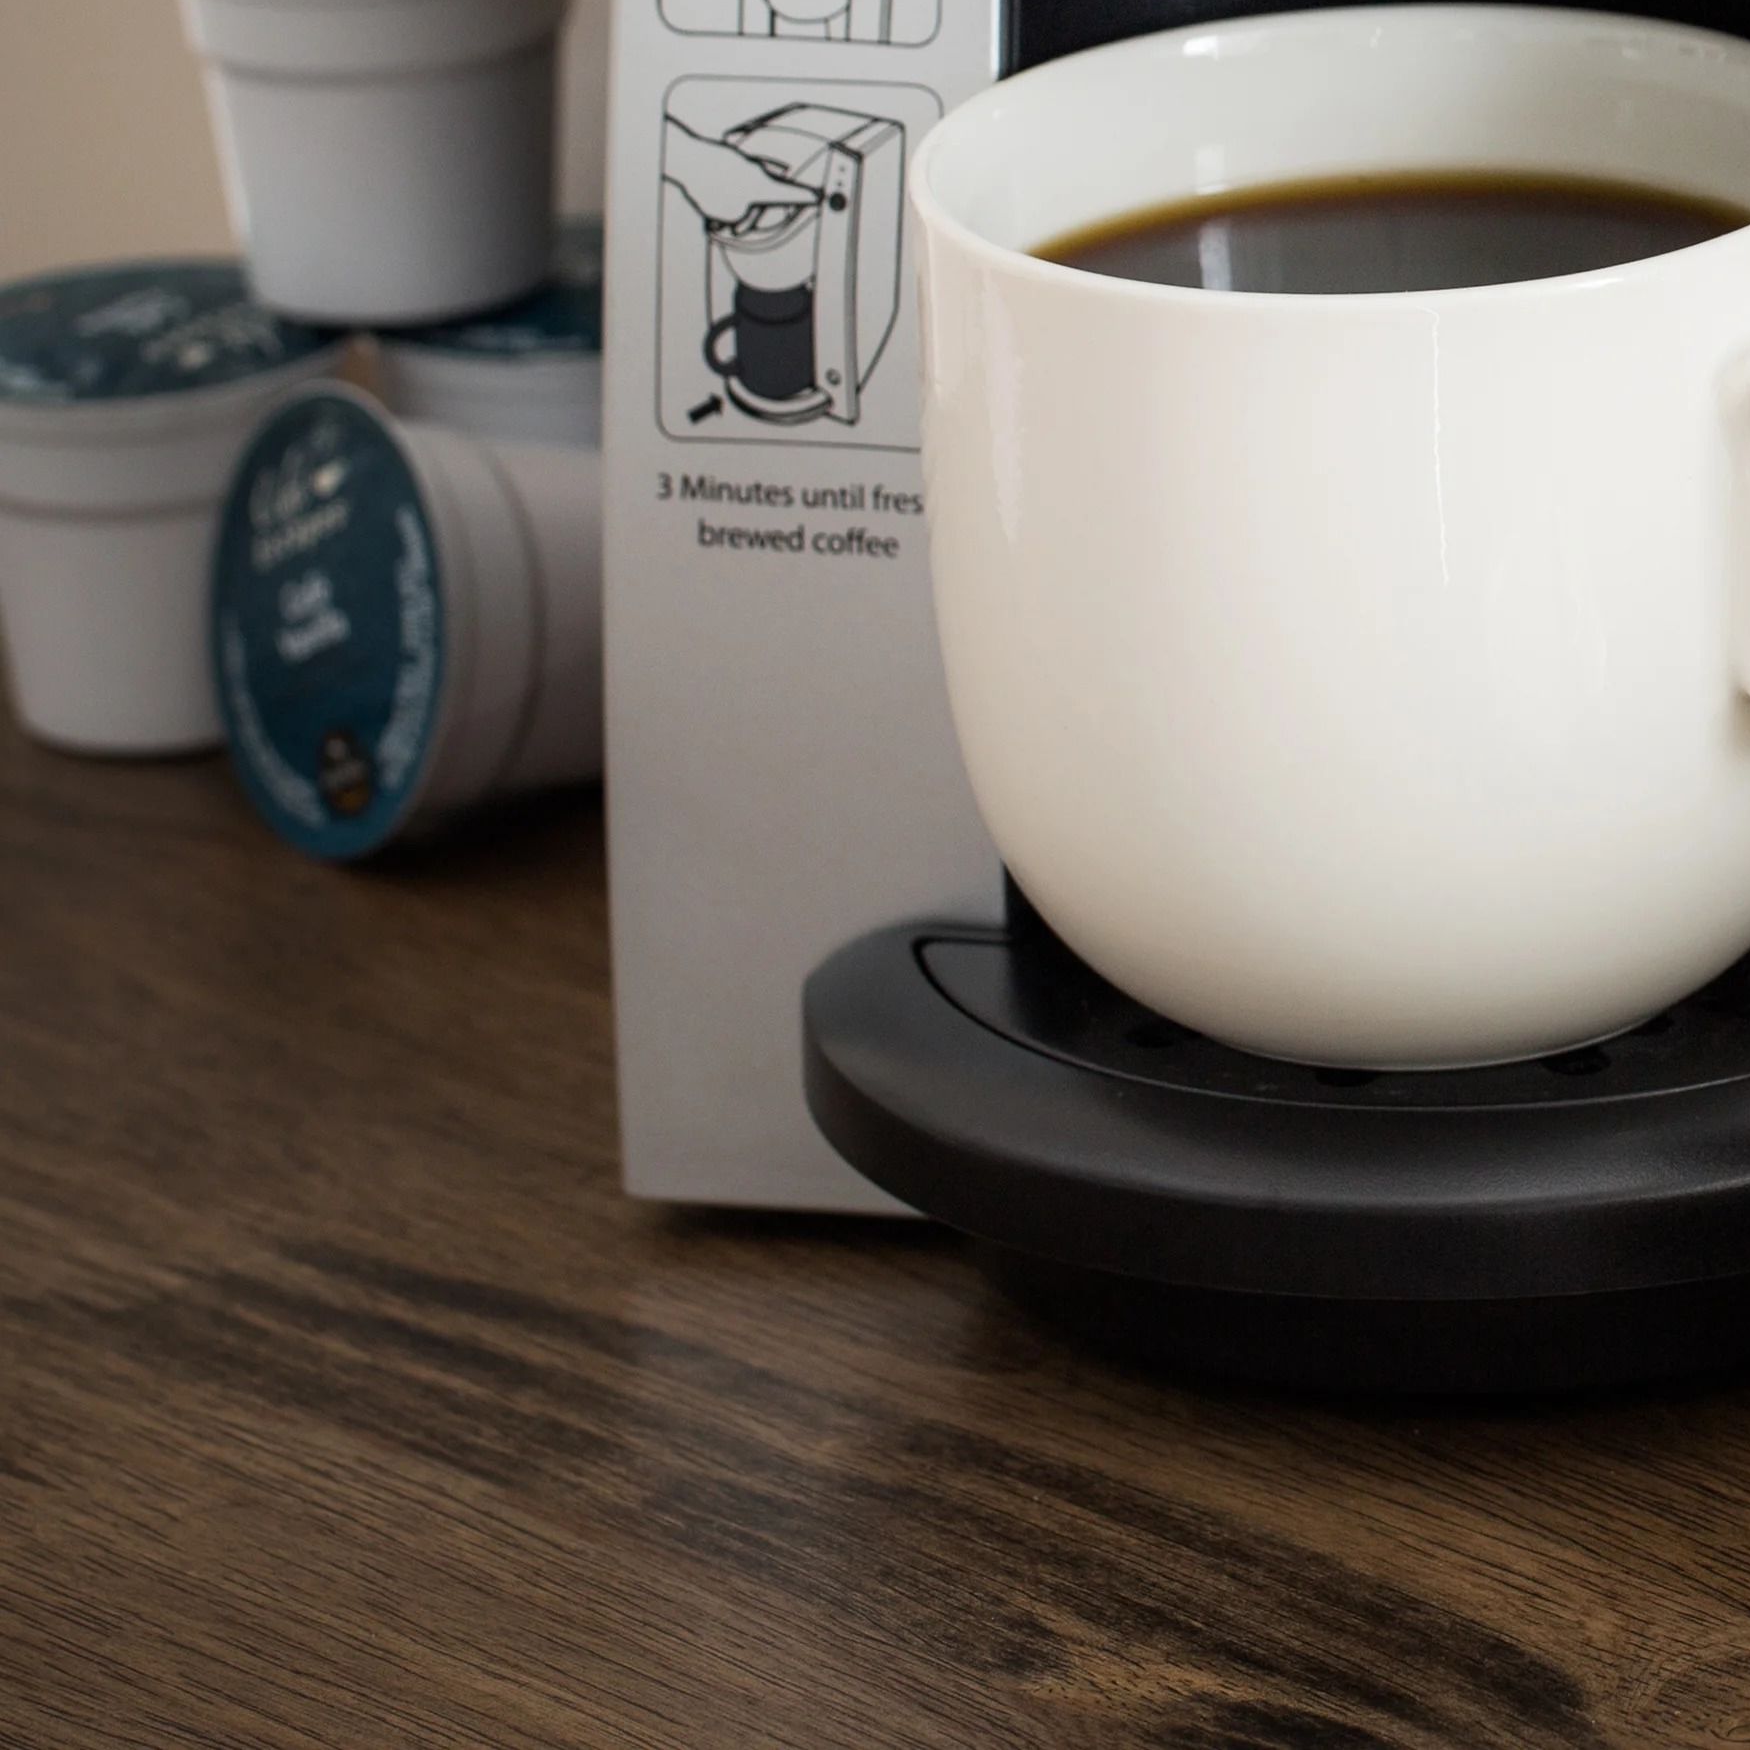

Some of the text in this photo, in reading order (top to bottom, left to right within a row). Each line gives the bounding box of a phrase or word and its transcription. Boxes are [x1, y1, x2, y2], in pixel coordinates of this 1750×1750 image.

[657, 472, 924, 515] 3 Minutes until fres
[697, 519, 899, 559] brewed coffee
